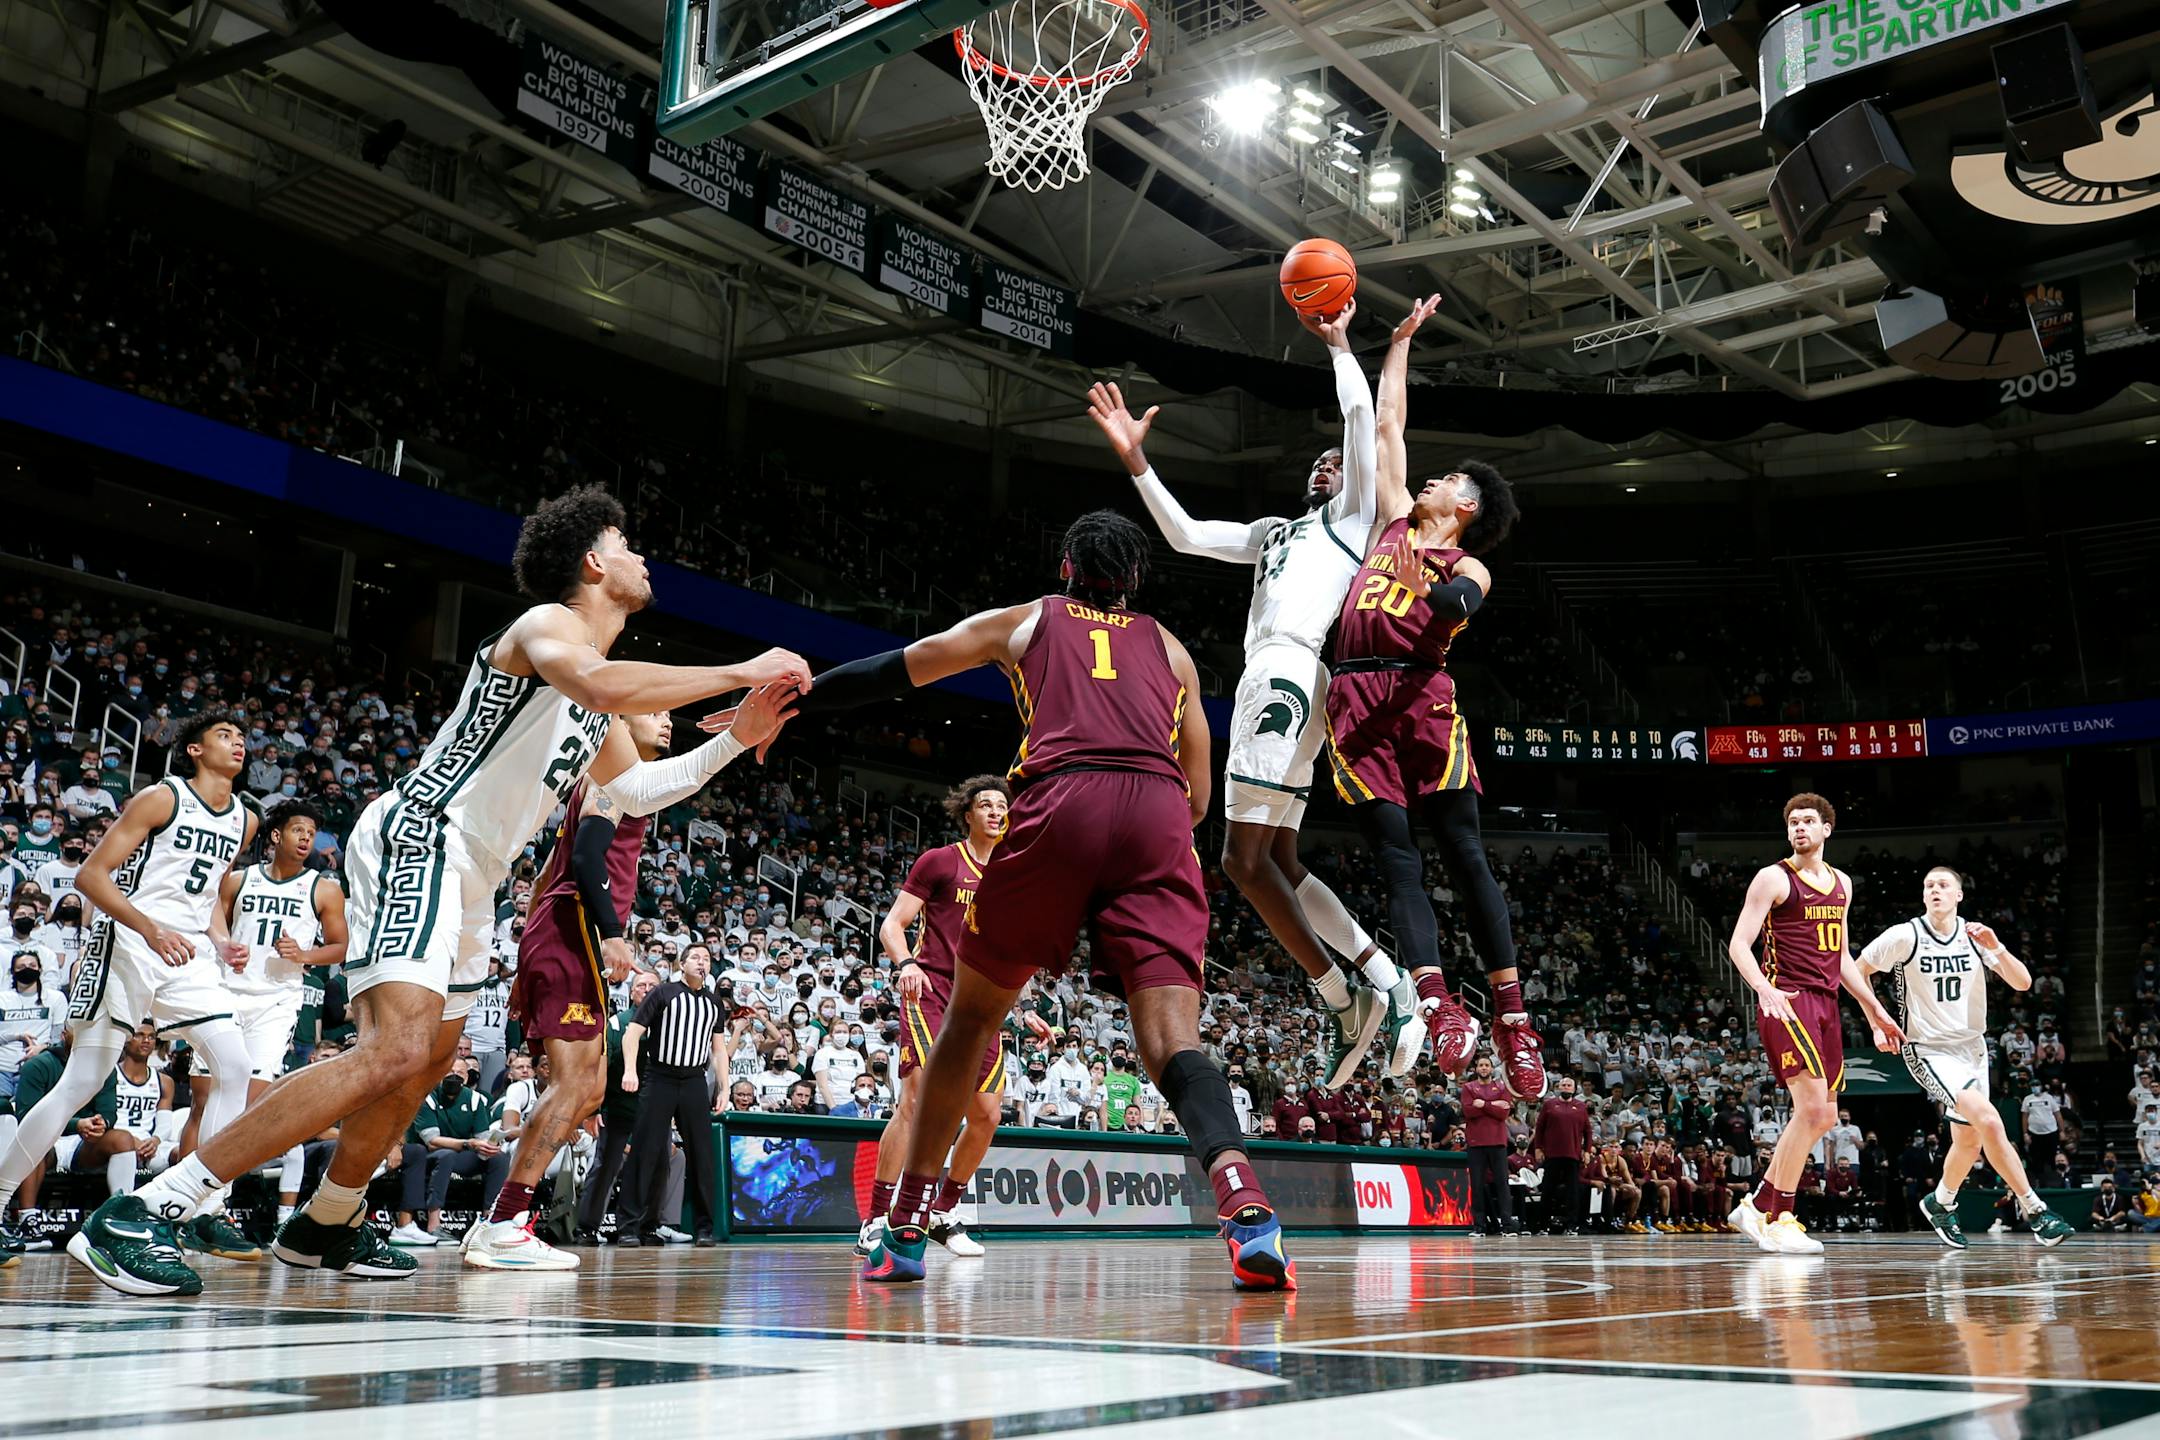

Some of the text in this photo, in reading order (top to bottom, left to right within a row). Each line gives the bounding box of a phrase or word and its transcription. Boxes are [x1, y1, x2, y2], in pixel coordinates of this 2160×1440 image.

[1805, 0, 1887, 41] THE
[541, 42, 627, 100] WOMEN'S
[547, 65, 617, 113] BIG TEN
[524, 71, 635, 140] CHAMPIONS
[554, 110, 601, 146] 1997
[654, 138, 754, 199] CHAMPIONS
[707, 150, 737, 174] TEN
[679, 172, 727, 208] 2005
[780, 168, 839, 207] WOMEN'S
[777, 197, 866, 248] CHAMPIONS
[778, 182, 866, 233] TOURNAMENT
[792, 223, 845, 262] 2005
[896, 223, 961, 266] WOMEN'S
[884, 249, 970, 299] CHAMPIONS
[901, 242, 954, 277] BIG TEN
[909, 281, 942, 306] 2011
[995, 268, 1064, 304] WOMEN'S
[1001, 287, 1057, 315] BIG TEN
[985, 295, 1073, 335] CHAMPIONS
[1009, 321, 1048, 345] 2014
[2000, 363, 2077, 404] 2005
[1355, 575, 1417, 618] 20
[1065, 602, 1135, 629] CURRY
[1088, 628, 1118, 680] 1
[1494, 727, 1514, 742] FG%
[1525, 728, 1551, 743] 3FG%
[1562, 729, 1581, 744] FT%
[1593, 730, 1600, 744] R
[1611, 730, 1619, 744] A
[1630, 730, 1637, 744] B
[1746, 730, 1766, 744] FG%
[1779, 729, 1806, 743] 3FG%
[1818, 727, 1837, 742] FT%
[1849, 726, 1857, 740] R
[1869, 725, 1877, 739] A
[1889, 725, 1896, 738] B
[1974, 717, 2115, 740] PNC PRIVATE BANK
[1529, 746, 1548, 758] 45.5
[1592, 747, 1603, 759] 23
[1612, 748, 1622, 759] 12
[1651, 748, 1662, 759] 10
[1783, 746, 1802, 757] 35.7
[1869, 743, 1881, 754] 10
[1891, 742, 1898, 753] 3
[18, 849, 58, 862] MICHIGAN
[173, 825, 239, 863] STATE
[184, 858, 214, 894] 5
[242, 894, 304, 918] STATE
[1804, 905, 1844, 920] MINNESO
[256, 918, 283, 947] 11
[1816, 922, 1842, 952] 10
[1920, 953, 1972, 974] STATE
[1933, 976, 1962, 1002] 10
[4, 1009, 42, 1020] IZZONE
[484, 1010, 501, 1028] 12
[116, 1095, 158, 1111] STATE
[128, 1110, 143, 1127] 2
[1353, 1180, 1393, 1209] ION
